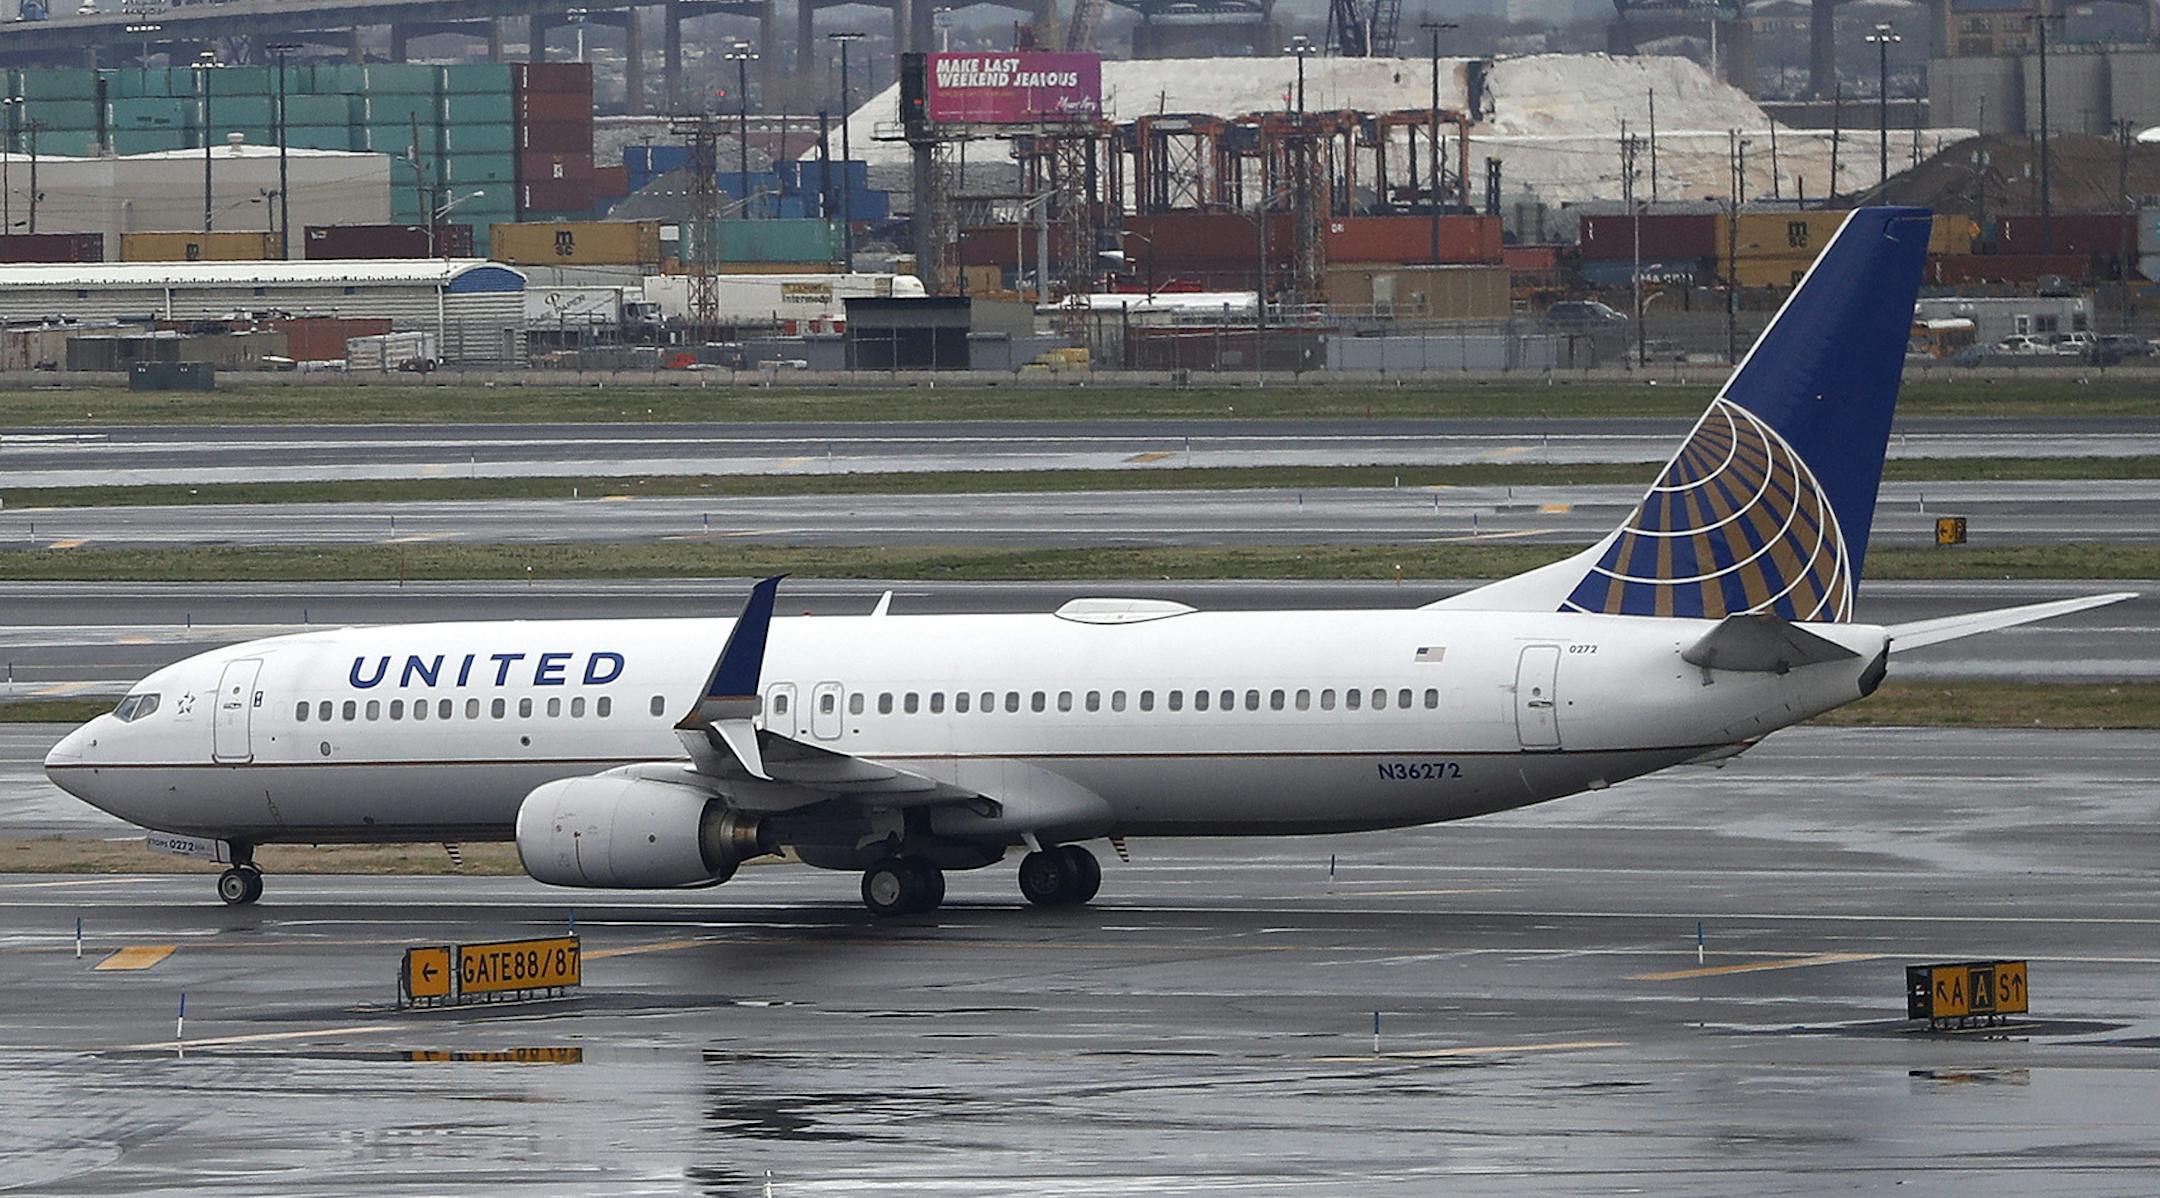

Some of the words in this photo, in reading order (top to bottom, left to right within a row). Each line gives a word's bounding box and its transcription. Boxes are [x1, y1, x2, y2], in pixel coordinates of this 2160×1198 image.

[936, 59, 980, 73] MAKE
[984, 58, 1020, 73] LAST
[937, 73, 1009, 87] WEEKEND
[1013, 72, 1078, 87] JEALOUS
[1569, 644, 1598, 654] 0272
[349, 651, 626, 689] UNITED
[1378, 762, 1463, 780] N36272
[169, 840, 194, 852] 0272
[1952, 976, 1965, 1007] A
[1975, 975, 1989, 1006] A
[1999, 973, 2011, 1003] S
